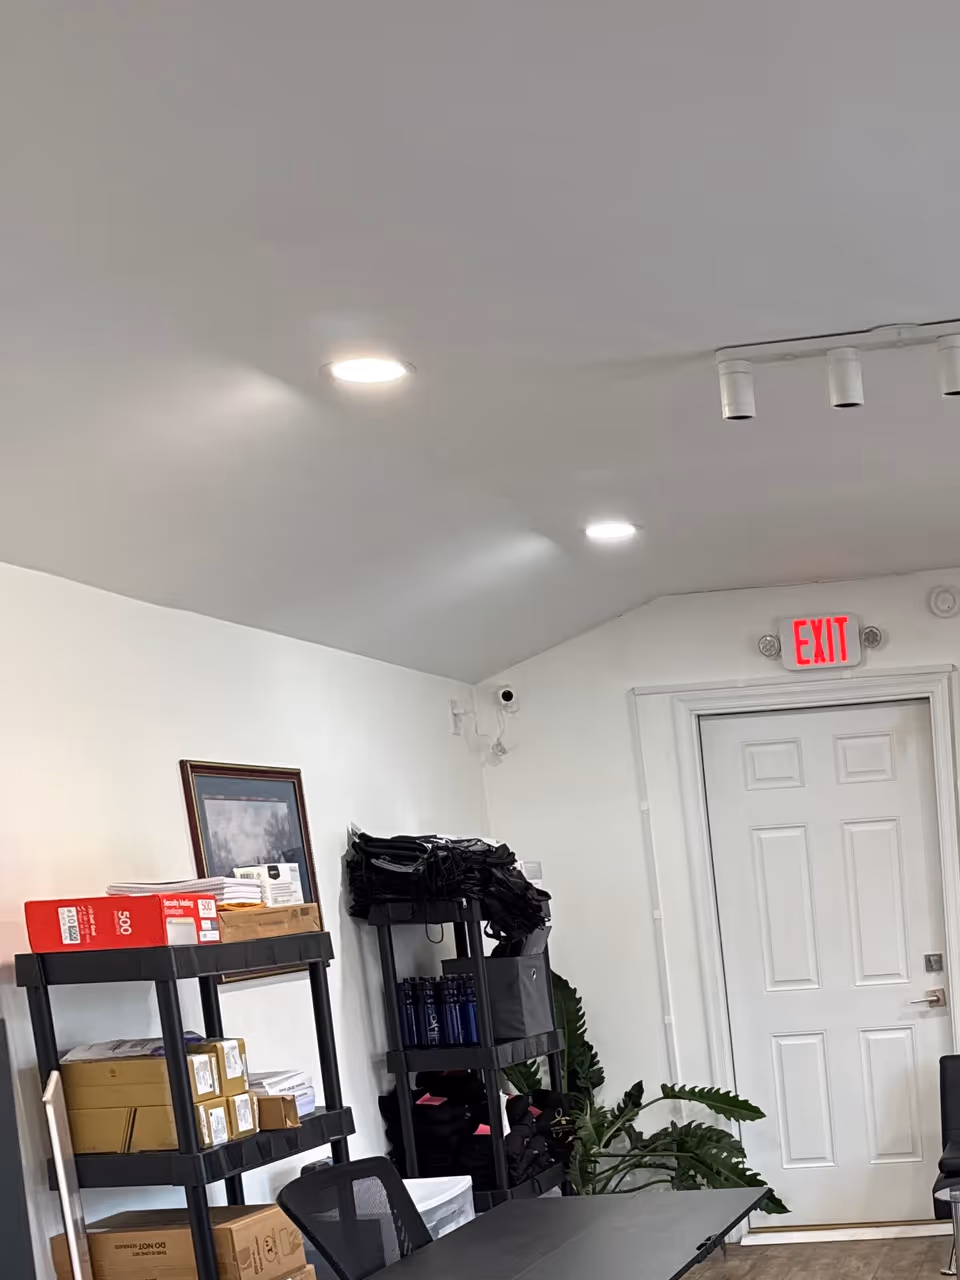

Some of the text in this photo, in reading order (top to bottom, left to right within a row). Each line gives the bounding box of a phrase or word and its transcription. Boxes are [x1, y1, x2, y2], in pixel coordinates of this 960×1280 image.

[793, 615, 848, 666] EXIT
[201, 900, 212, 911] 500
[118, 910, 132, 935] 500
[138, 1242, 154, 1250] NOT
